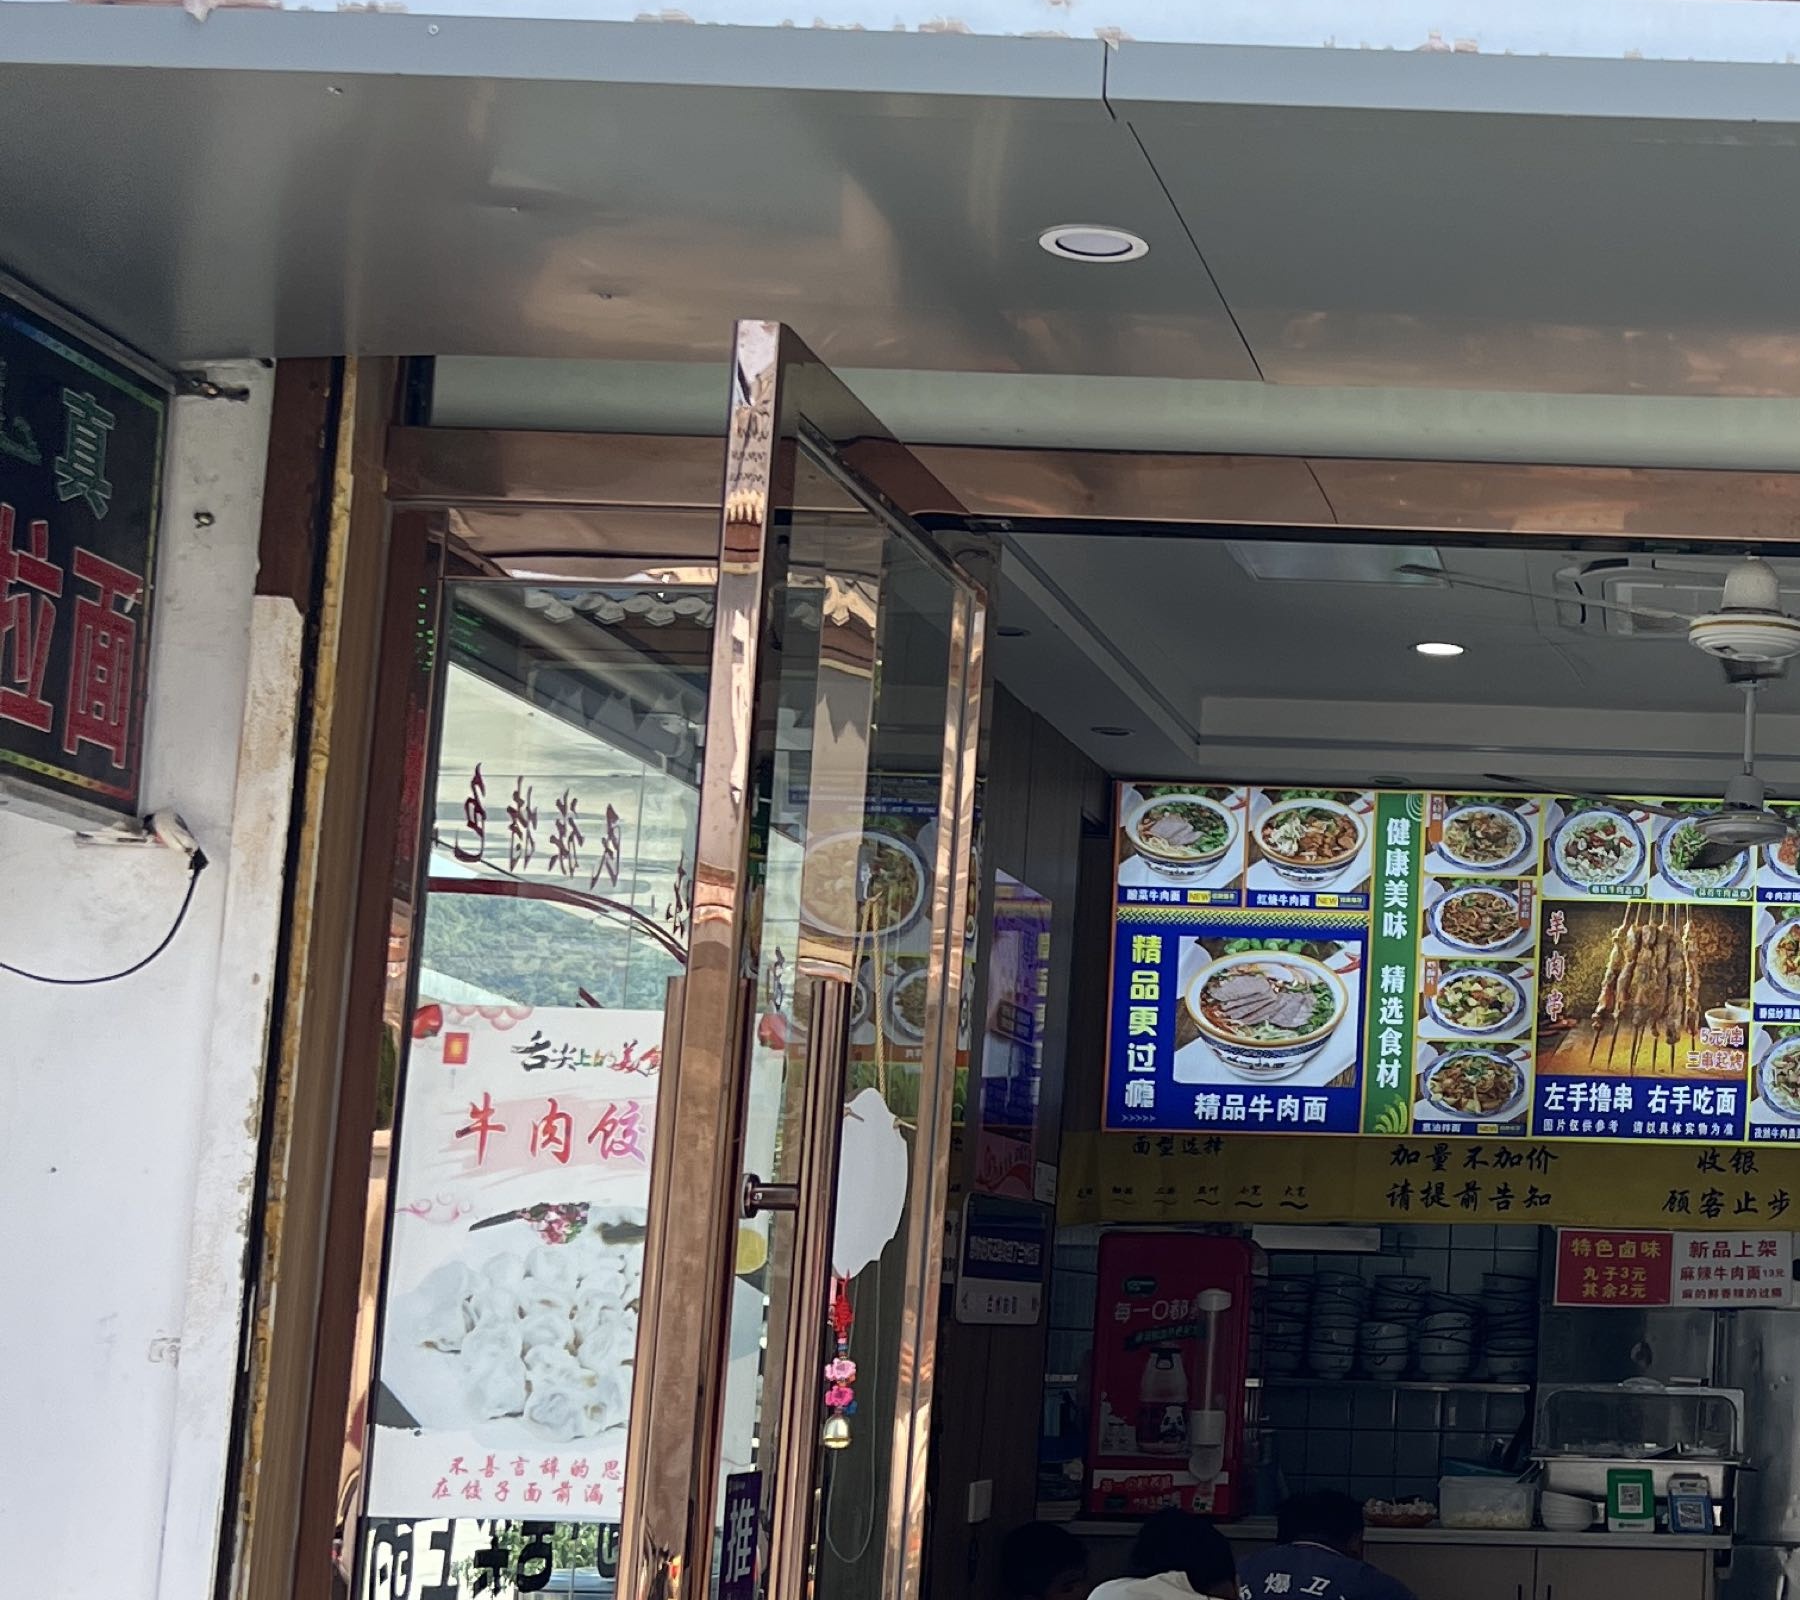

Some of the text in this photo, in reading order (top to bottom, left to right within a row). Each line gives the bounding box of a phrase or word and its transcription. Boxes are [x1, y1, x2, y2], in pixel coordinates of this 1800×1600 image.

[1376, 817, 1411, 1089] 健康美味 精选食材
[1545, 910, 1567, 1022] 羊肉串
[1125, 935, 1162, 1108] 精品更过瘾
[1194, 1092, 1329, 1123] 精品牛肉面
[1544, 1082, 1738, 1117] 左手撸串 右手吃面
[1390, 1143, 1559, 1175] 加量不加价
[1697, 1147, 1760, 1176] 收银
[1386, 1178, 1553, 1211] 请提前告知
[1662, 1186, 1792, 1221] 顾客止步
[1571, 1238, 1662, 1259] 特色卤味
[1689, 1239, 1777, 1258] 新品上架
[1583, 1266, 1647, 1282] 丸子3元
